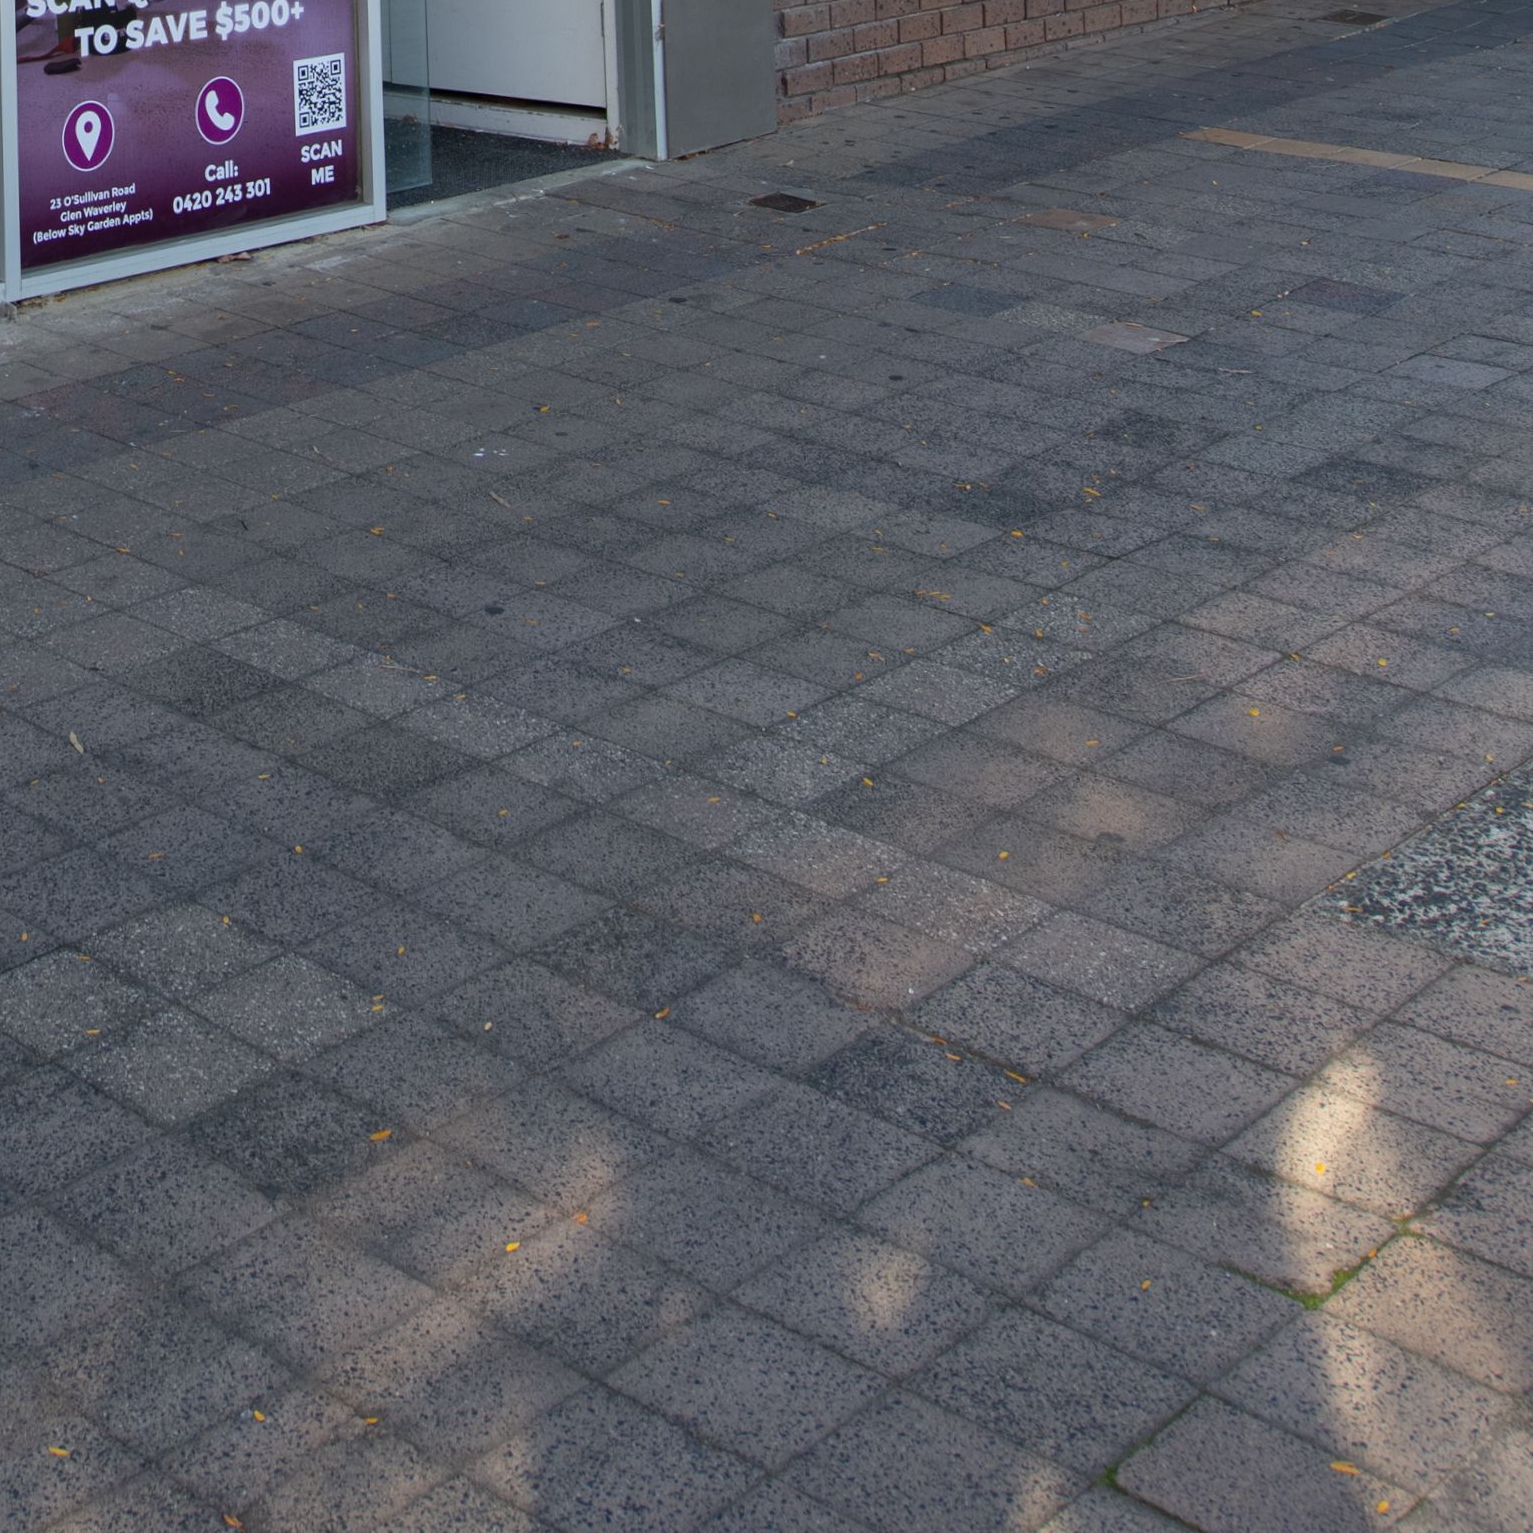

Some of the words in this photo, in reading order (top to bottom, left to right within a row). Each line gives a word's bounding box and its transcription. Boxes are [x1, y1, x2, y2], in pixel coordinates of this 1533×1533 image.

[74, 25, 118, 58] TO
[125, 9, 208, 50] SAVE
[215, 0, 305, 41] $500+
[300, 140, 343, 164] SCAN
[204, 160, 239, 182] Call:
[310, 166, 335, 186] ME
[49, 197, 62, 211] 23
[63, 188, 110, 208] O'Sullivan
[111, 183, 136, 200] Road
[172, 191, 212, 215] 0420
[215, 185, 245, 208] 243
[246, 178, 271, 200] 301
[60, 206, 82, 223] Glen
[83, 199, 127, 221] Waverley
[33, 229, 67, 245] (Below
[68, 223, 85, 239] Sky
[86, 215, 121, 235] Garden
[122, 208, 153, 228] Appts)
